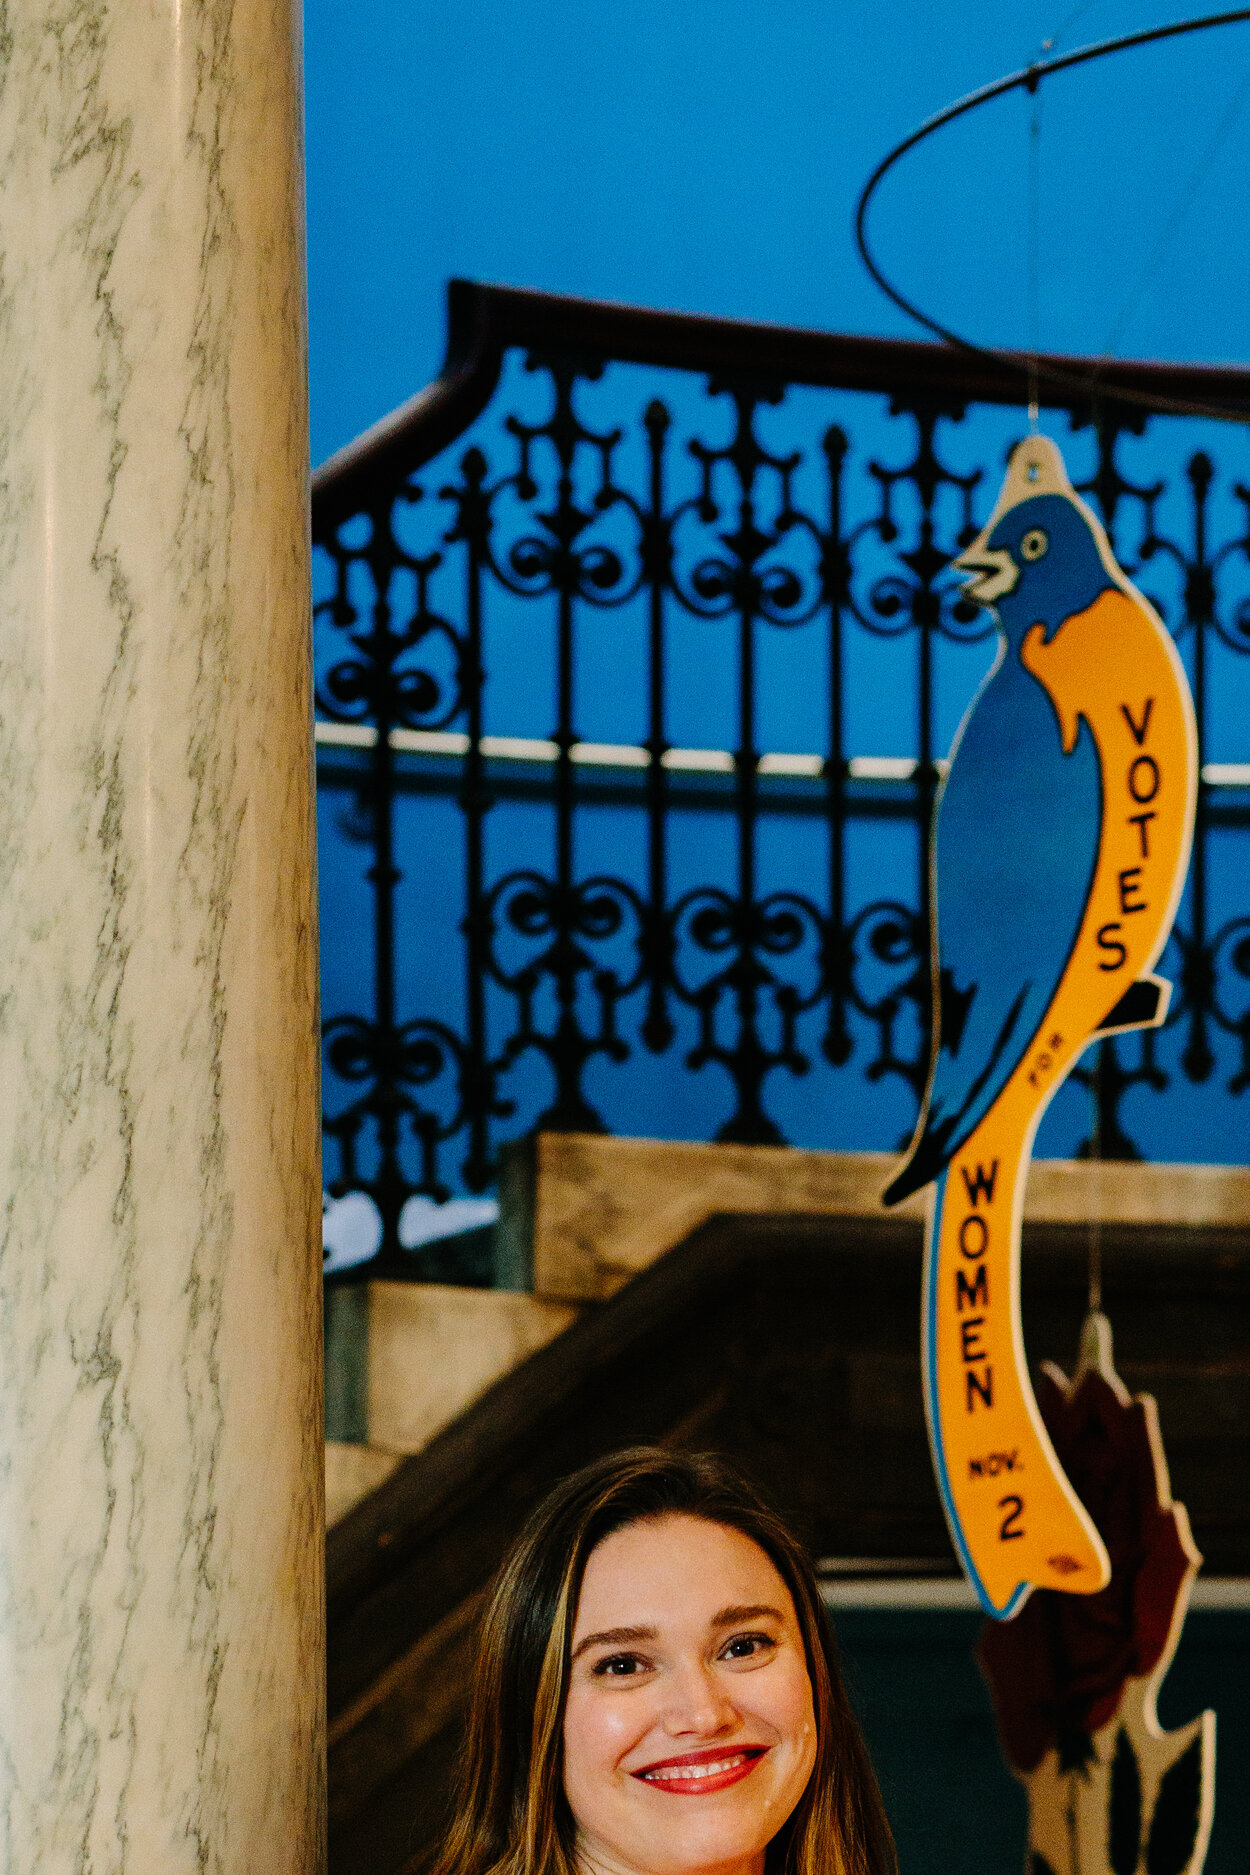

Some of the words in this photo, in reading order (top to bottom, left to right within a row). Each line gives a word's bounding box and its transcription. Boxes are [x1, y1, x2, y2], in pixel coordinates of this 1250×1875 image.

[1096, 697, 1161, 972] VOTES
[1027, 1031, 1064, 1091] FOR
[956, 1157, 999, 1414] WOMEN
[998, 1493, 1024, 1541] 2
